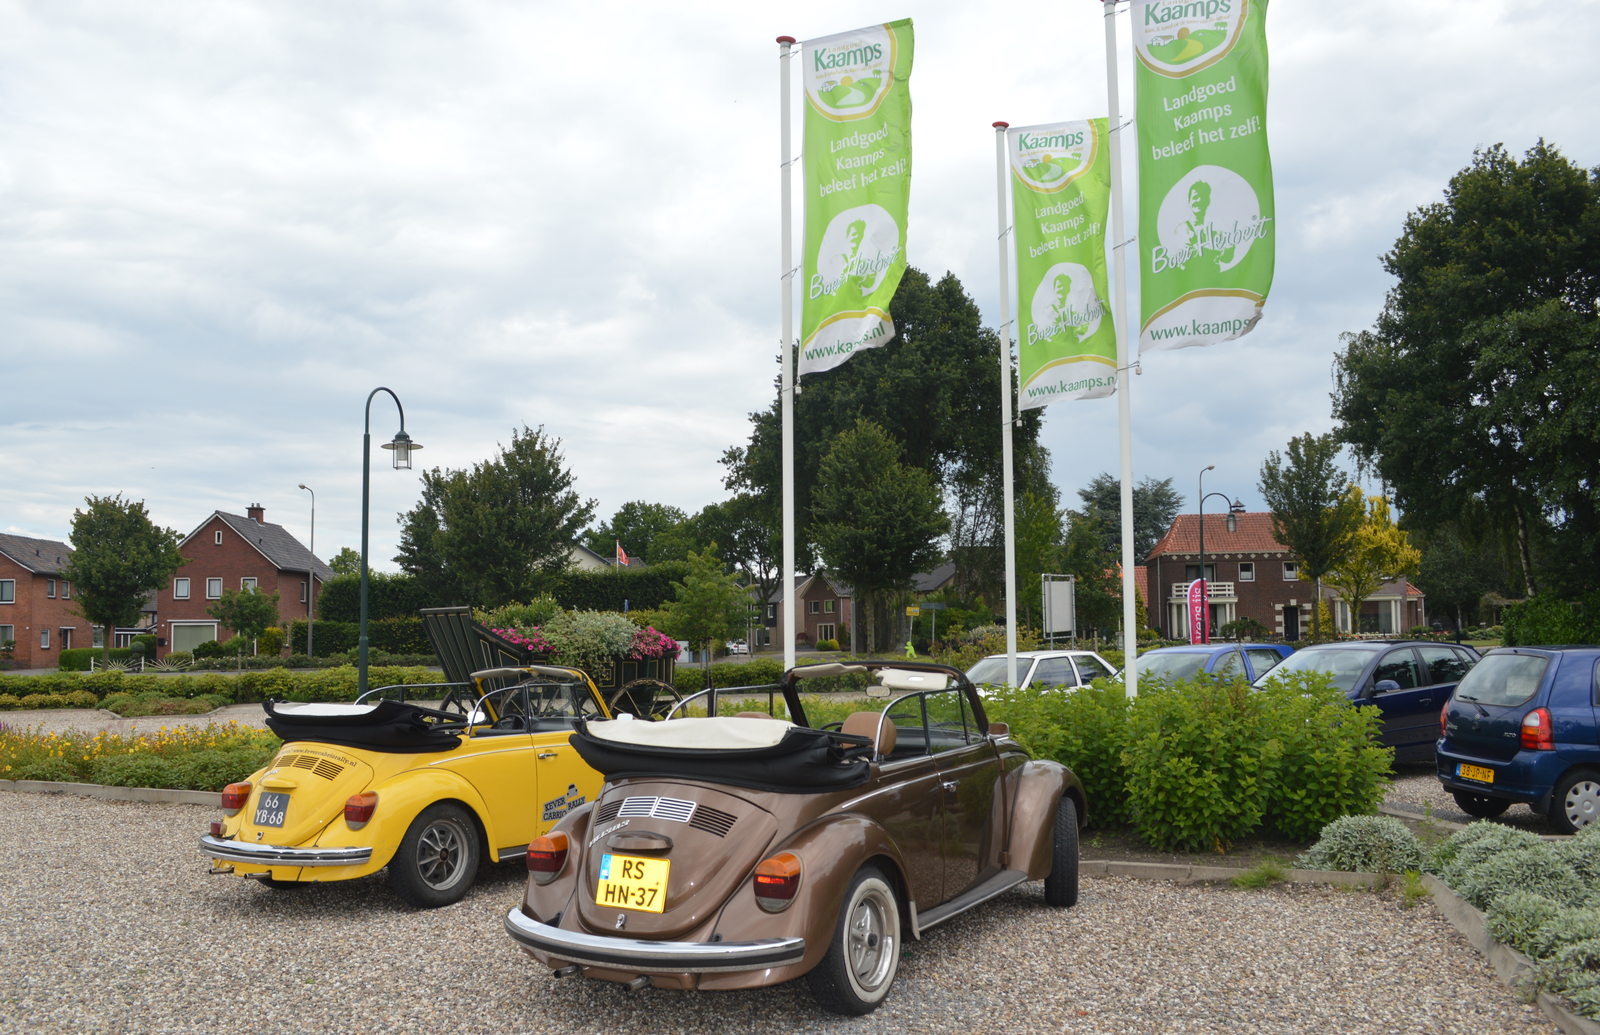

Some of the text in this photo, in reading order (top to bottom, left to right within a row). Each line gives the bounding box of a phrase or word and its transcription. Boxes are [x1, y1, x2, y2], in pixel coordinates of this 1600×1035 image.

[1144, 0, 1231, 26] Kaamps
[814, 43, 882, 71] Kaamps
[828, 40, 862, 52] Landgoed
[1163, 76, 1236, 112] Landgoed
[1174, 104, 1232, 132] Kaamps
[830, 122, 888, 153] Landgoed
[1019, 132, 1084, 151] Kaamps
[1152, 116, 1261, 160] beleef het zelf!
[836, 148, 885, 171] Kaamps
[820, 158, 906, 198] beleef het zelf!
[1035, 191, 1084, 219] Landgoed
[1041, 214, 1085, 234] Kaamps
[1029, 222, 1100, 258] beleef het zelf!
[1152, 216, 1272, 274] Boer Herbert
[805, 322, 885, 360] www.kas.nl
[1150, 319, 1250, 340] www.kaamps
[1028, 376, 1114, 398] www.kaamps.n
[265, 795, 279, 809] 66
[544, 796, 586, 812] KEVER RALLY
[543, 810, 567, 821] CABRIO
[622, 860, 645, 880] RS
[604, 884, 658, 908] HN-37
